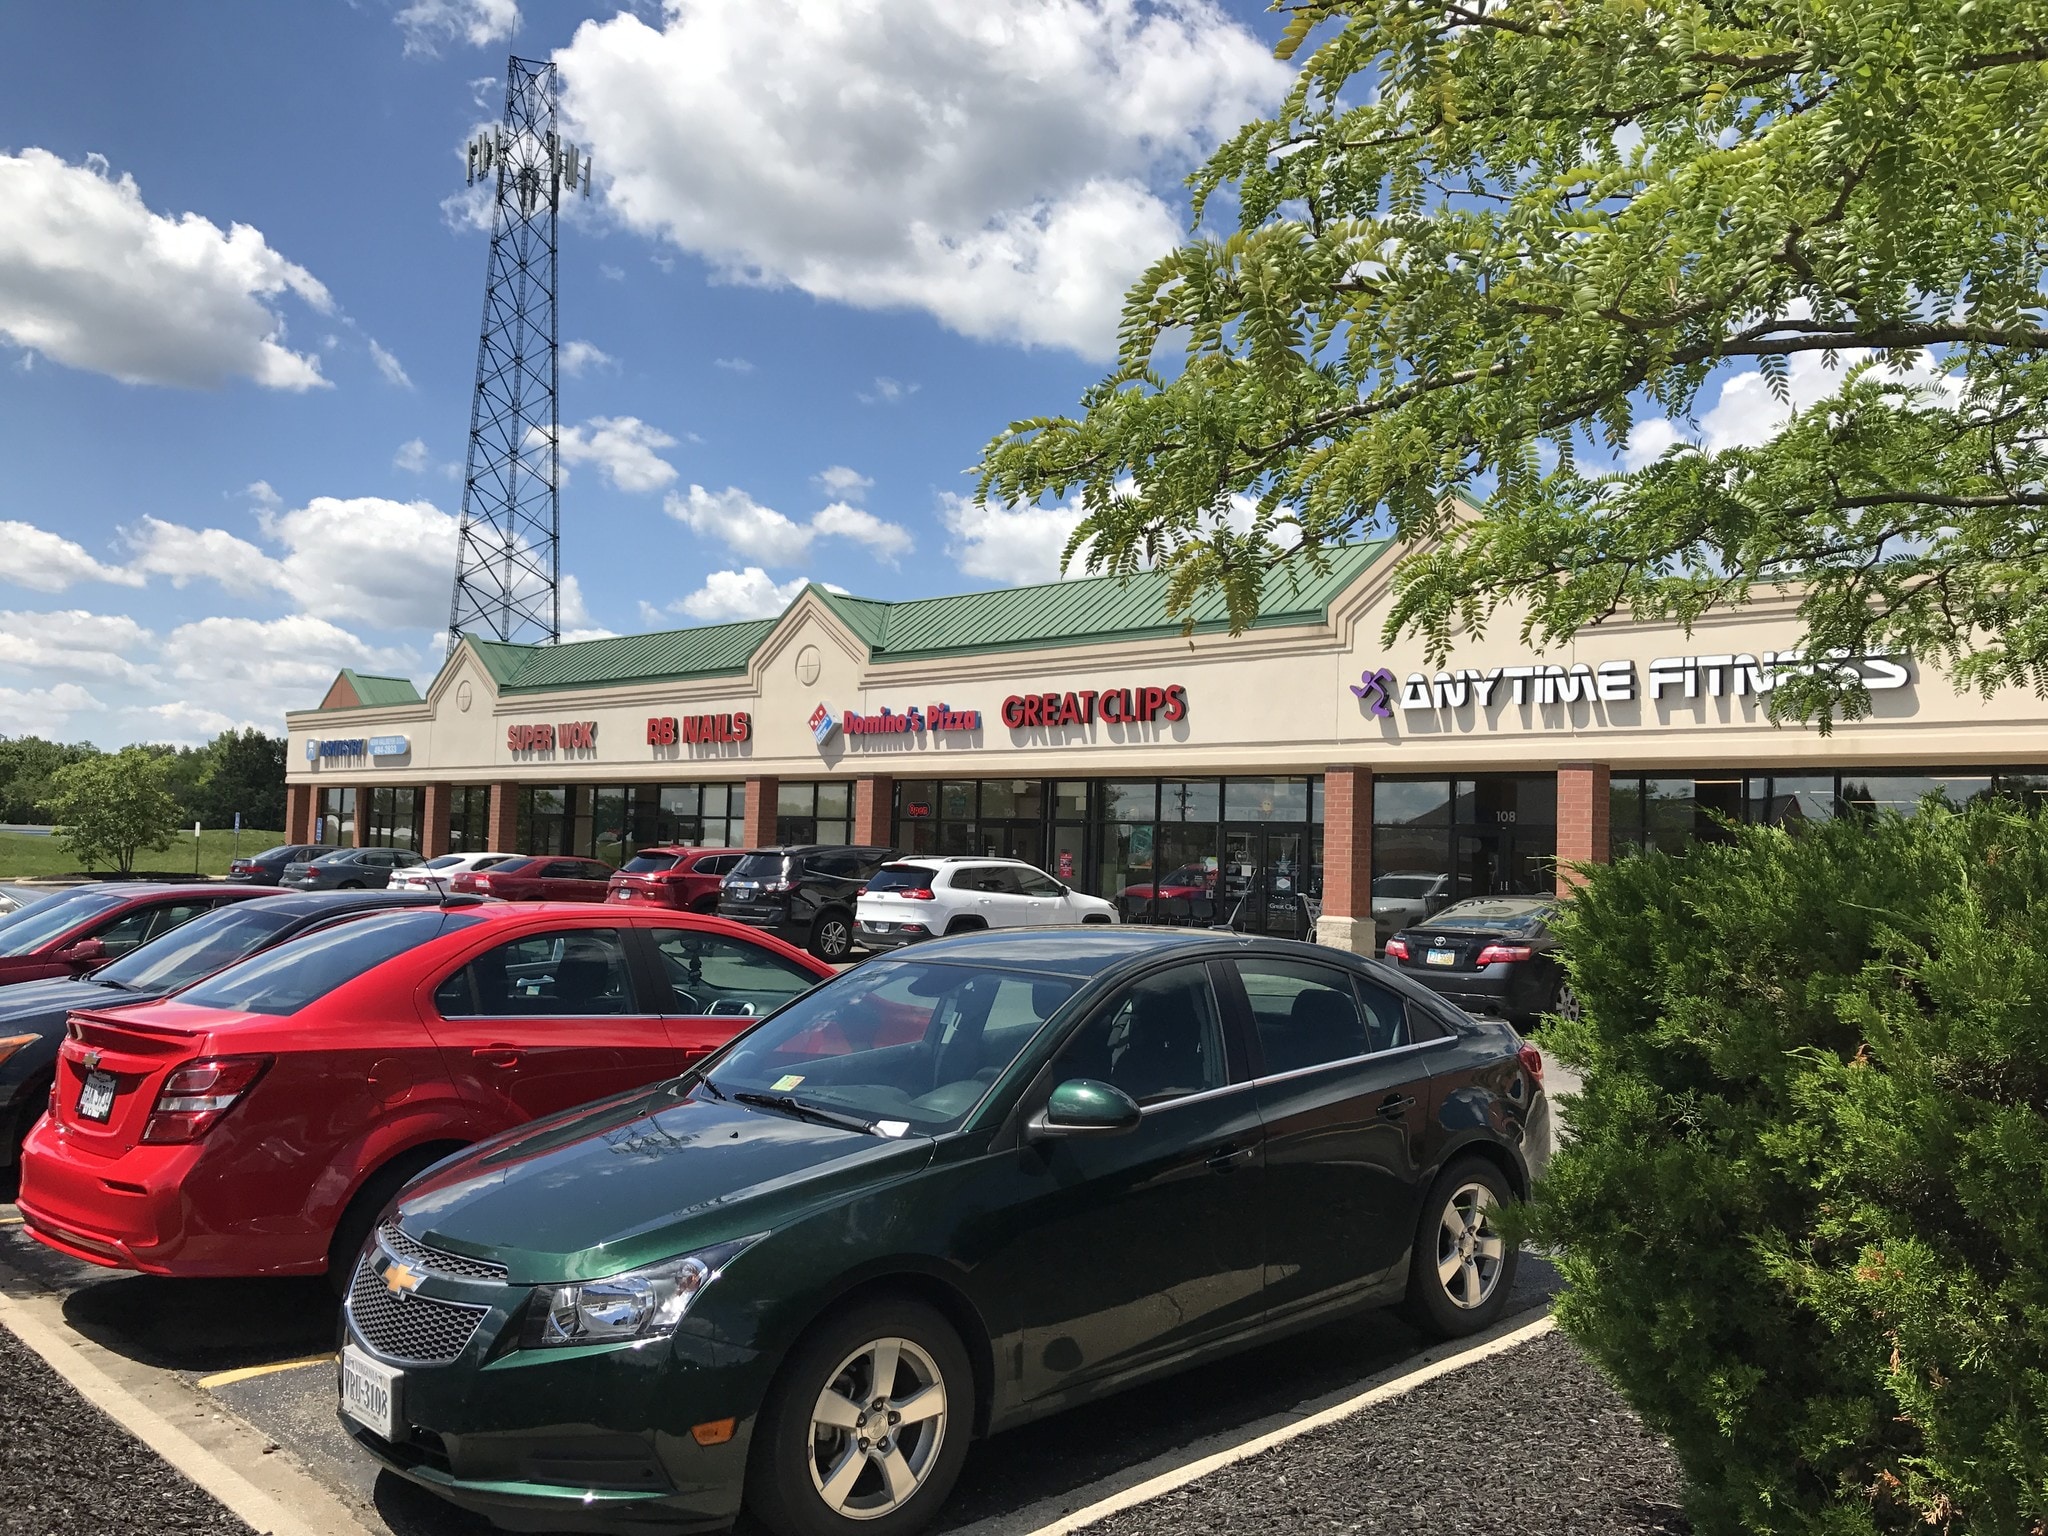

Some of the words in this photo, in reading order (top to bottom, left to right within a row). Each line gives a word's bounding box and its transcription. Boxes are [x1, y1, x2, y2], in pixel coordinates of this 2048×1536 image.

[1399, 659, 1635, 709] ANYTIME
[843, 706, 922, 735] Domino's
[927, 702, 978, 732] Pizza
[1001, 690, 1098, 729] GREAT
[1098, 684, 1186, 724] CLIPS
[507, 724, 554, 752] SUPER
[558, 721, 595, 749] WOK
[647, 716, 677, 746] RB
[682, 711, 750, 744] NAILS
[1495, 810, 1516, 822] 108
